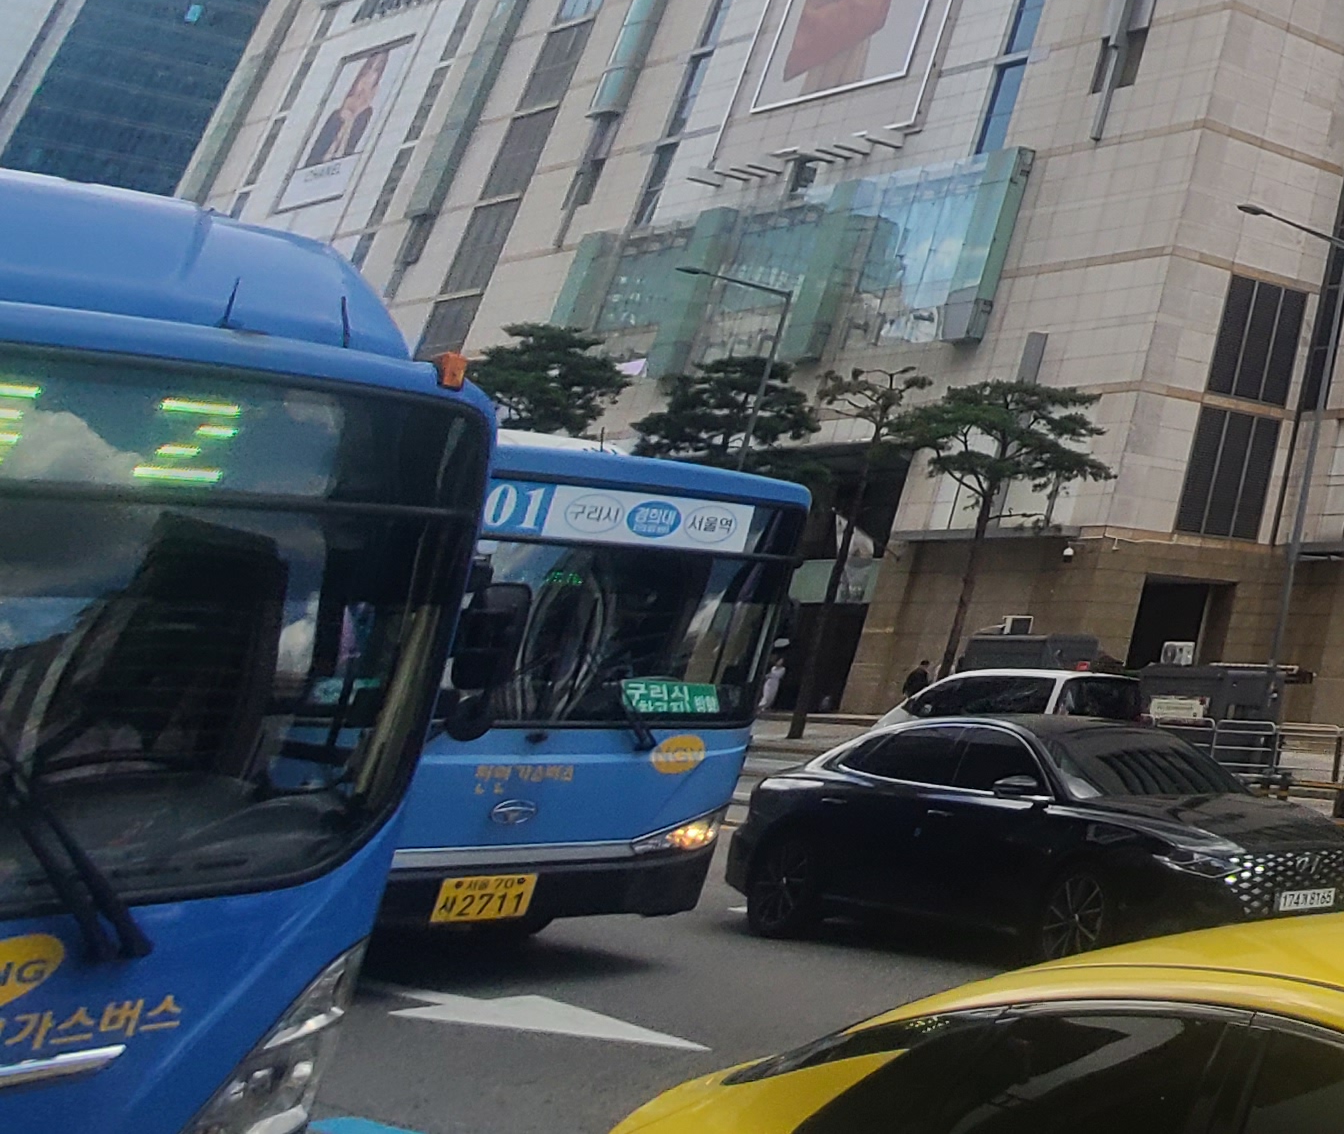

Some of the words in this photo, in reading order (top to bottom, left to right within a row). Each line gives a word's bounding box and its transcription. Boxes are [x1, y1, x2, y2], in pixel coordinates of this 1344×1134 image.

[569, 503, 621, 524] 구리시
[688, 514, 734, 534] 서울역
[626, 683, 690, 706] 구리시
[0, 994, 182, 1051] 가스버스
